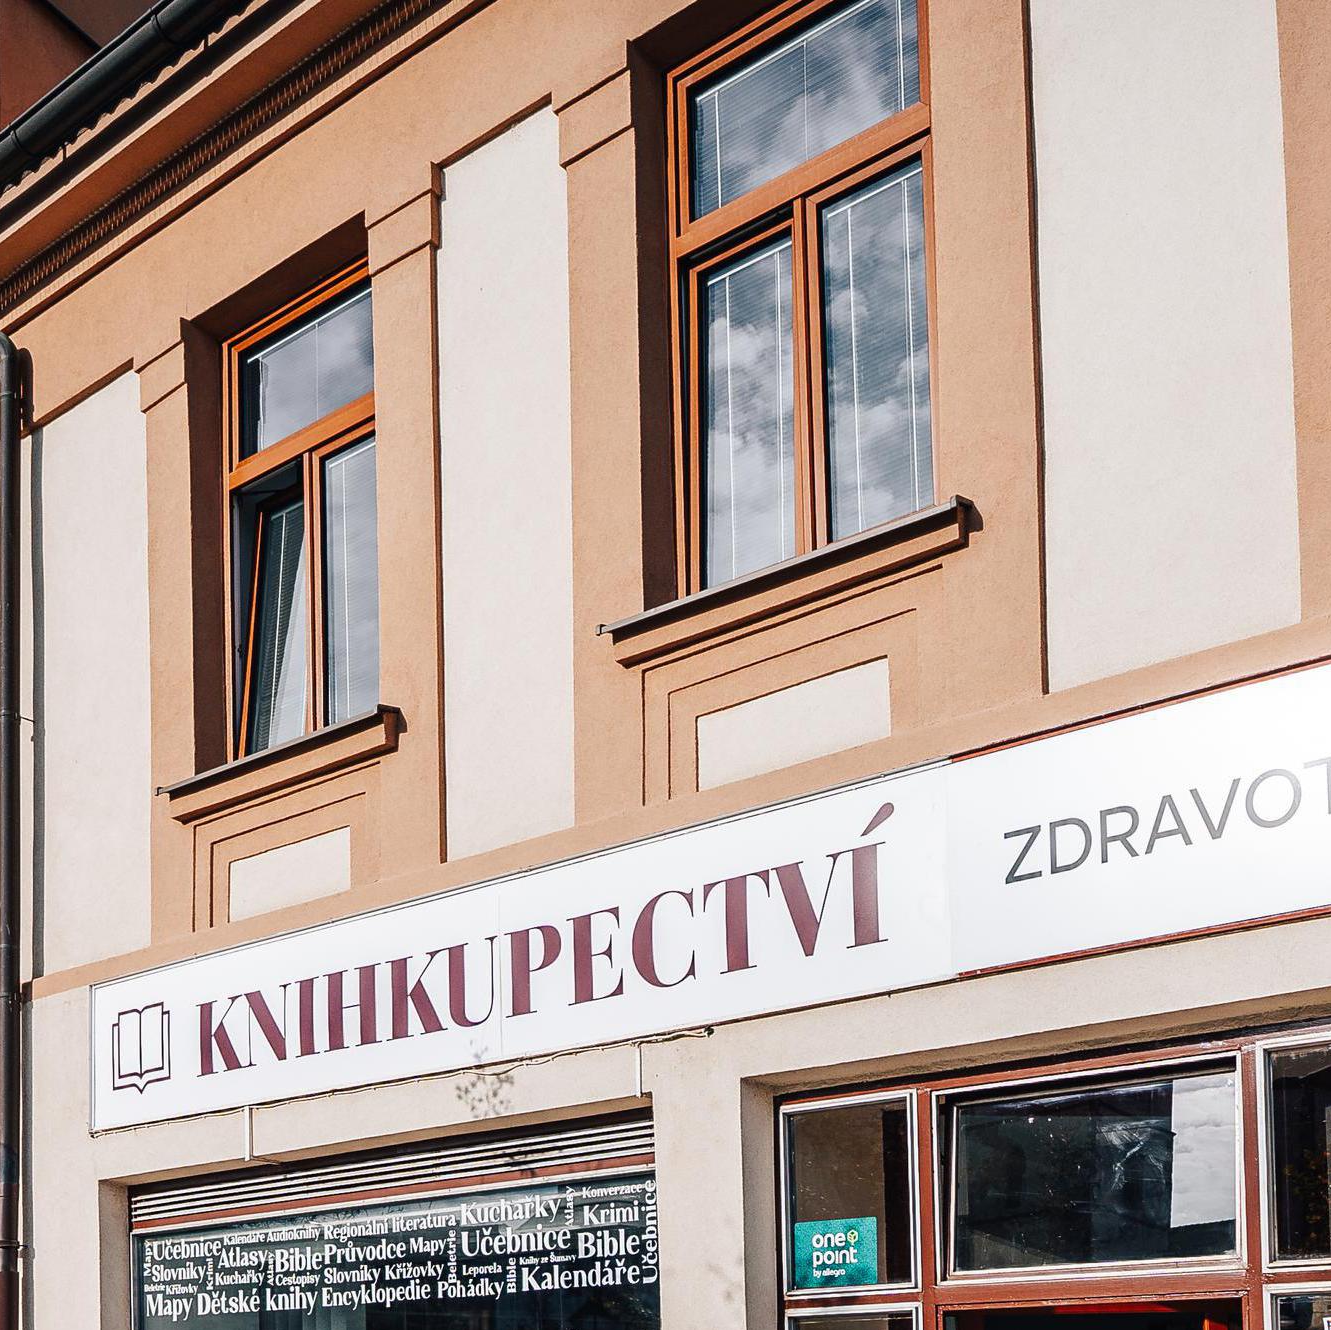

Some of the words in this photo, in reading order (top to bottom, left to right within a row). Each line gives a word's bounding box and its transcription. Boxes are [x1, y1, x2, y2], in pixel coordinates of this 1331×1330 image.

[196, 802, 895, 1078] KNIHKUPECTVÍ
[582, 1184, 643, 1199] Konverzace
[460, 1193, 561, 1226] Kuchařky
[565, 1185, 575, 1226] Atlasy
[583, 1200, 640, 1226] Krimi
[223, 1232, 266, 1246] Kalendáře
[267, 1227, 321, 1244] Audioknihy
[324, 1219, 389, 1243] Regionální
[392, 1214, 457, 1233] literatura
[461, 1223, 571, 1257] Učebnice
[641, 1179, 658, 1284] Učebnice
[811, 1231, 846, 1249] one
[152, 1239, 221, 1261] Učebnice
[324, 1238, 406, 1265] Průvodce
[409, 1237, 447, 1256] Mapy
[447, 1229, 457, 1283] Beletrie
[577, 1228, 641, 1259] Bible
[218, 1246, 269, 1271] Atlasy
[275, 1246, 322, 1273] Bible
[385, 1261, 445, 1281] Křížovky
[462, 1263, 502, 1276] Leporela
[812, 1247, 858, 1269] point
[151, 1261, 206, 1283] Slovníky
[206, 1258, 214, 1290] Krimi
[215, 1270, 265, 1286] Kuchařky
[275, 1272, 321, 1287] Cestopisy
[324, 1265, 381, 1285] Slovníky
[506, 1257, 517, 1293] Bible
[521, 1258, 641, 1292] Kalendáře
[813, 1269, 822, 1279] by
[823, 1268, 846, 1278] allegro
[197, 1290, 260, 1316] Dětské
[266, 1286, 318, 1316] knihy
[322, 1279, 431, 1311] Encyklopedie
[438, 1278, 504, 1299] Pohádky
[146, 1294, 193, 1322] Mapy
